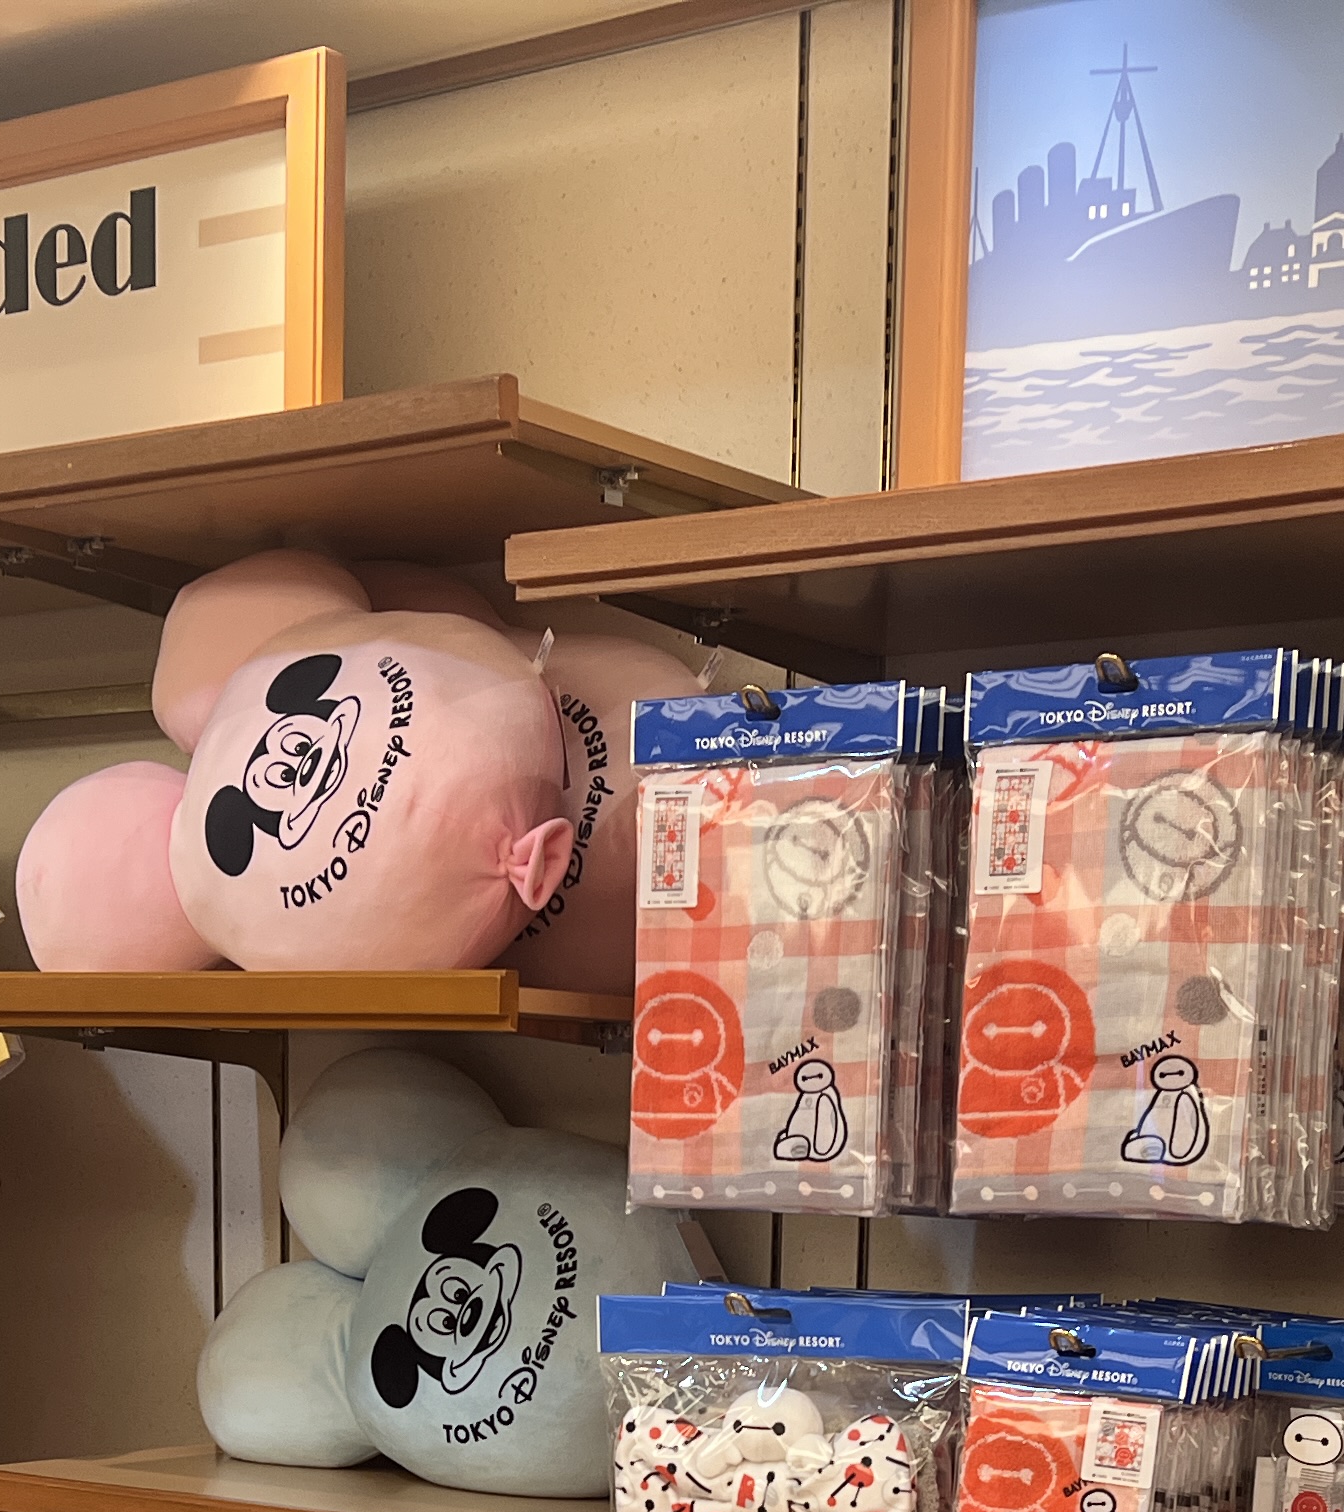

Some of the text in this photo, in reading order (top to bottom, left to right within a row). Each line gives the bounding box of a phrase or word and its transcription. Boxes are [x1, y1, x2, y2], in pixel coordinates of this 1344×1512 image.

[1039, 700, 1193, 726] TOKYO Disney RESORT
[561, 700, 608, 772] RESORT
[694, 728, 828, 751] TOKYO Disney RESORT
[279, 663, 413, 910] TOKYO Disney RESORT
[768, 1035, 820, 1075] BAYMAX
[1120, 1029, 1182, 1068] BAYMAX
[442, 1208, 578, 1445] TOKYO Disney RESORT
[709, 1328, 841, 1353] TOKYO Disney RESORT
[1006, 1357, 1133, 1384] TOKYO Disney RESORT
[1268, 1371, 1294, 1382] TOKYO
[1063, 1478, 1094, 1498] BAY
